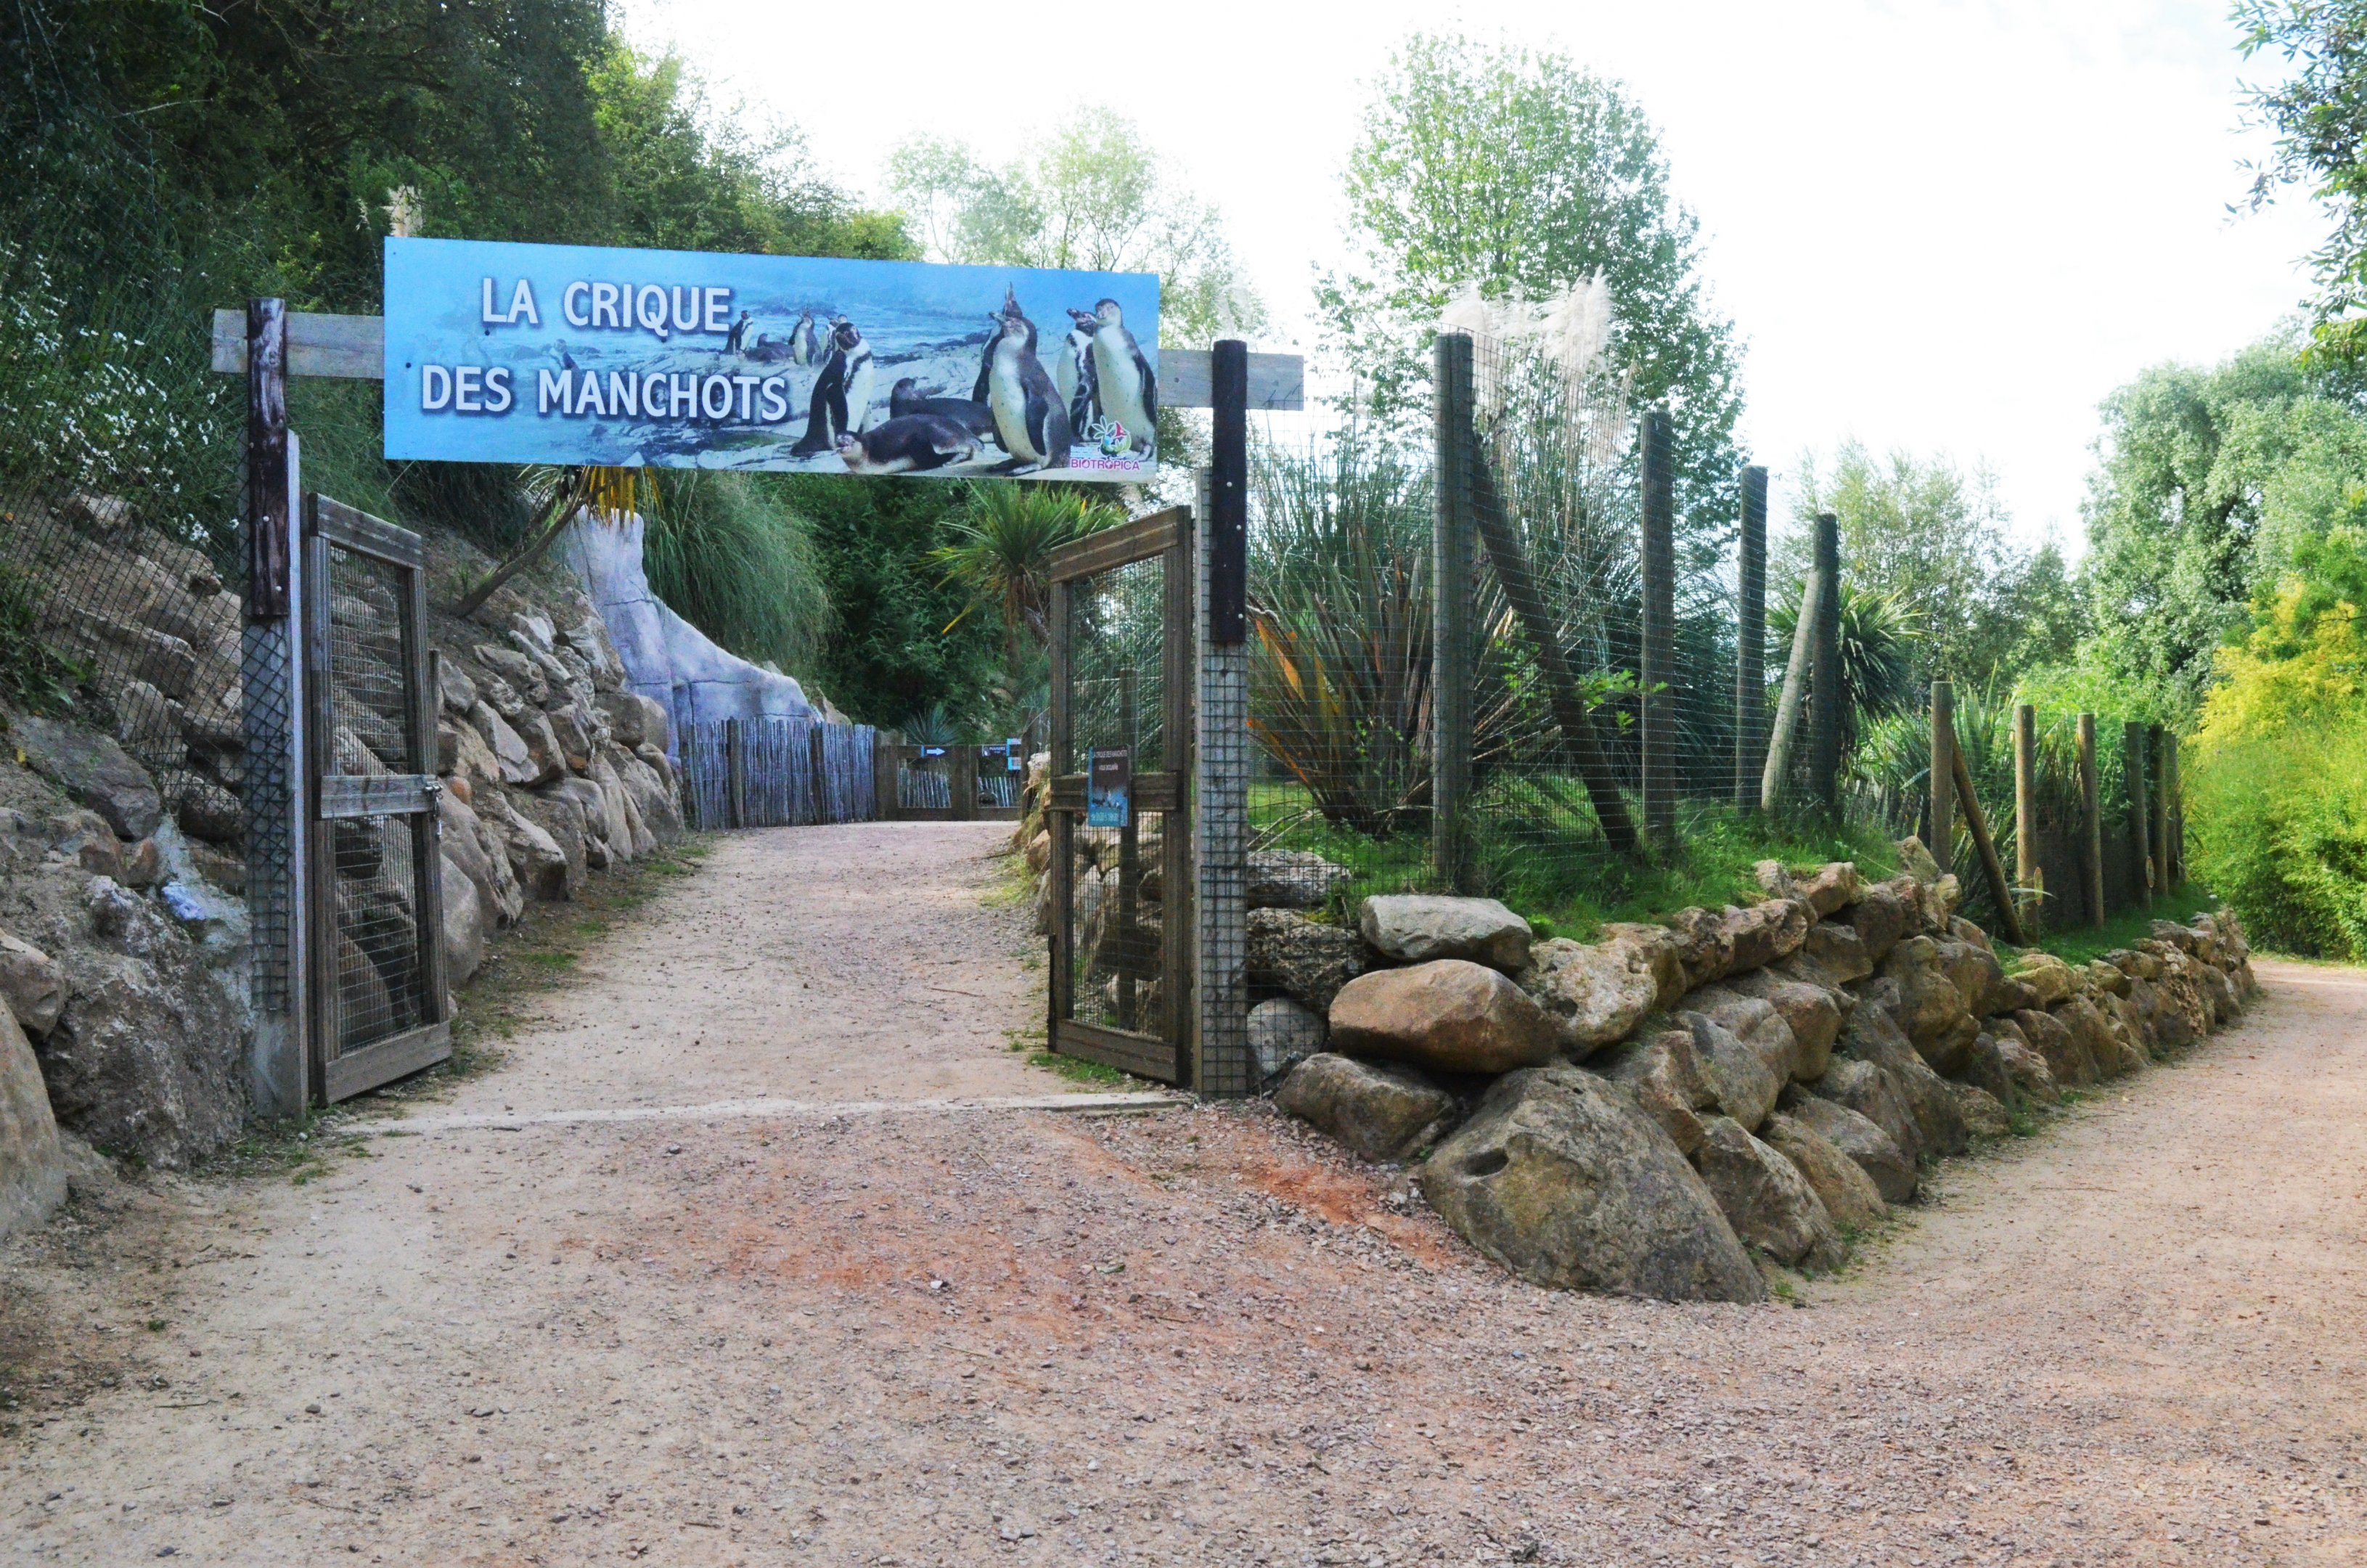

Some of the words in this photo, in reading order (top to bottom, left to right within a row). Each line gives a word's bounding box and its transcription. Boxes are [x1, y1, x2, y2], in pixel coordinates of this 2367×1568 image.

[483, 278, 539, 324] LA
[564, 282, 730, 337] CRIQUE
[422, 364, 511, 412] DES
[539, 369, 787, 421] MANCHOTS
[1071, 459, 1140, 470] BIOTROPICA
